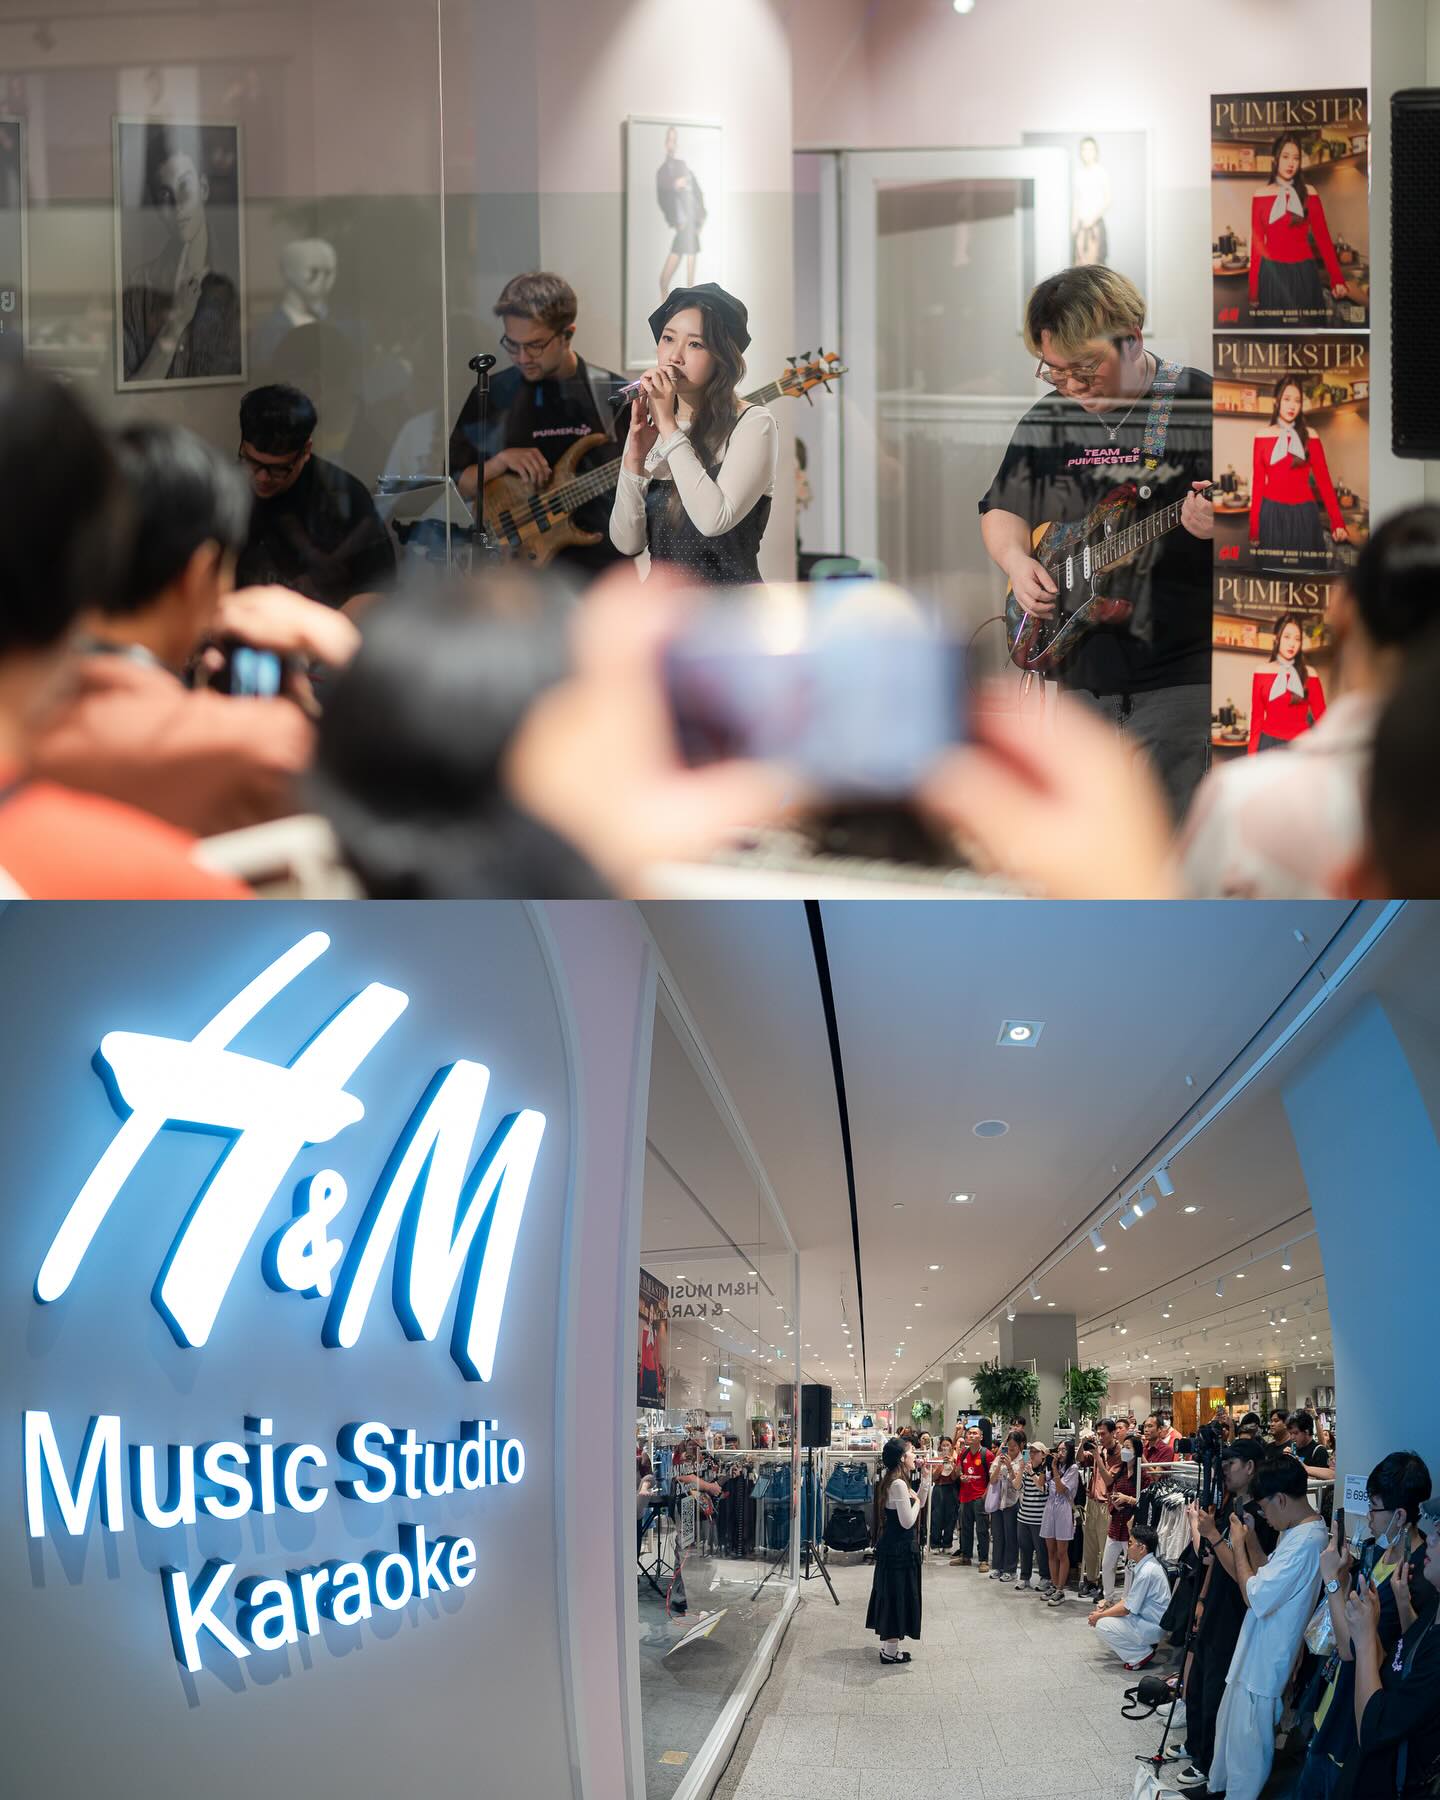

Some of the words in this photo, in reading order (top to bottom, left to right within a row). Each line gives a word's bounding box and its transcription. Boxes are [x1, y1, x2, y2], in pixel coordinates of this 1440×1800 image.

[1215, 98, 1363, 126] PUIMEKSTER
[1218, 343, 1364, 367] PUIMEKSTER
[1084, 448, 1120, 457] TEAM
[1218, 577, 1331, 607] PUIMEKST
[34, 931, 546, 1382] H&M
[24, 1410, 328, 1537] Music
[345, 1420, 525, 1504] Studio
[165, 1524, 477, 1672] Karaoke
